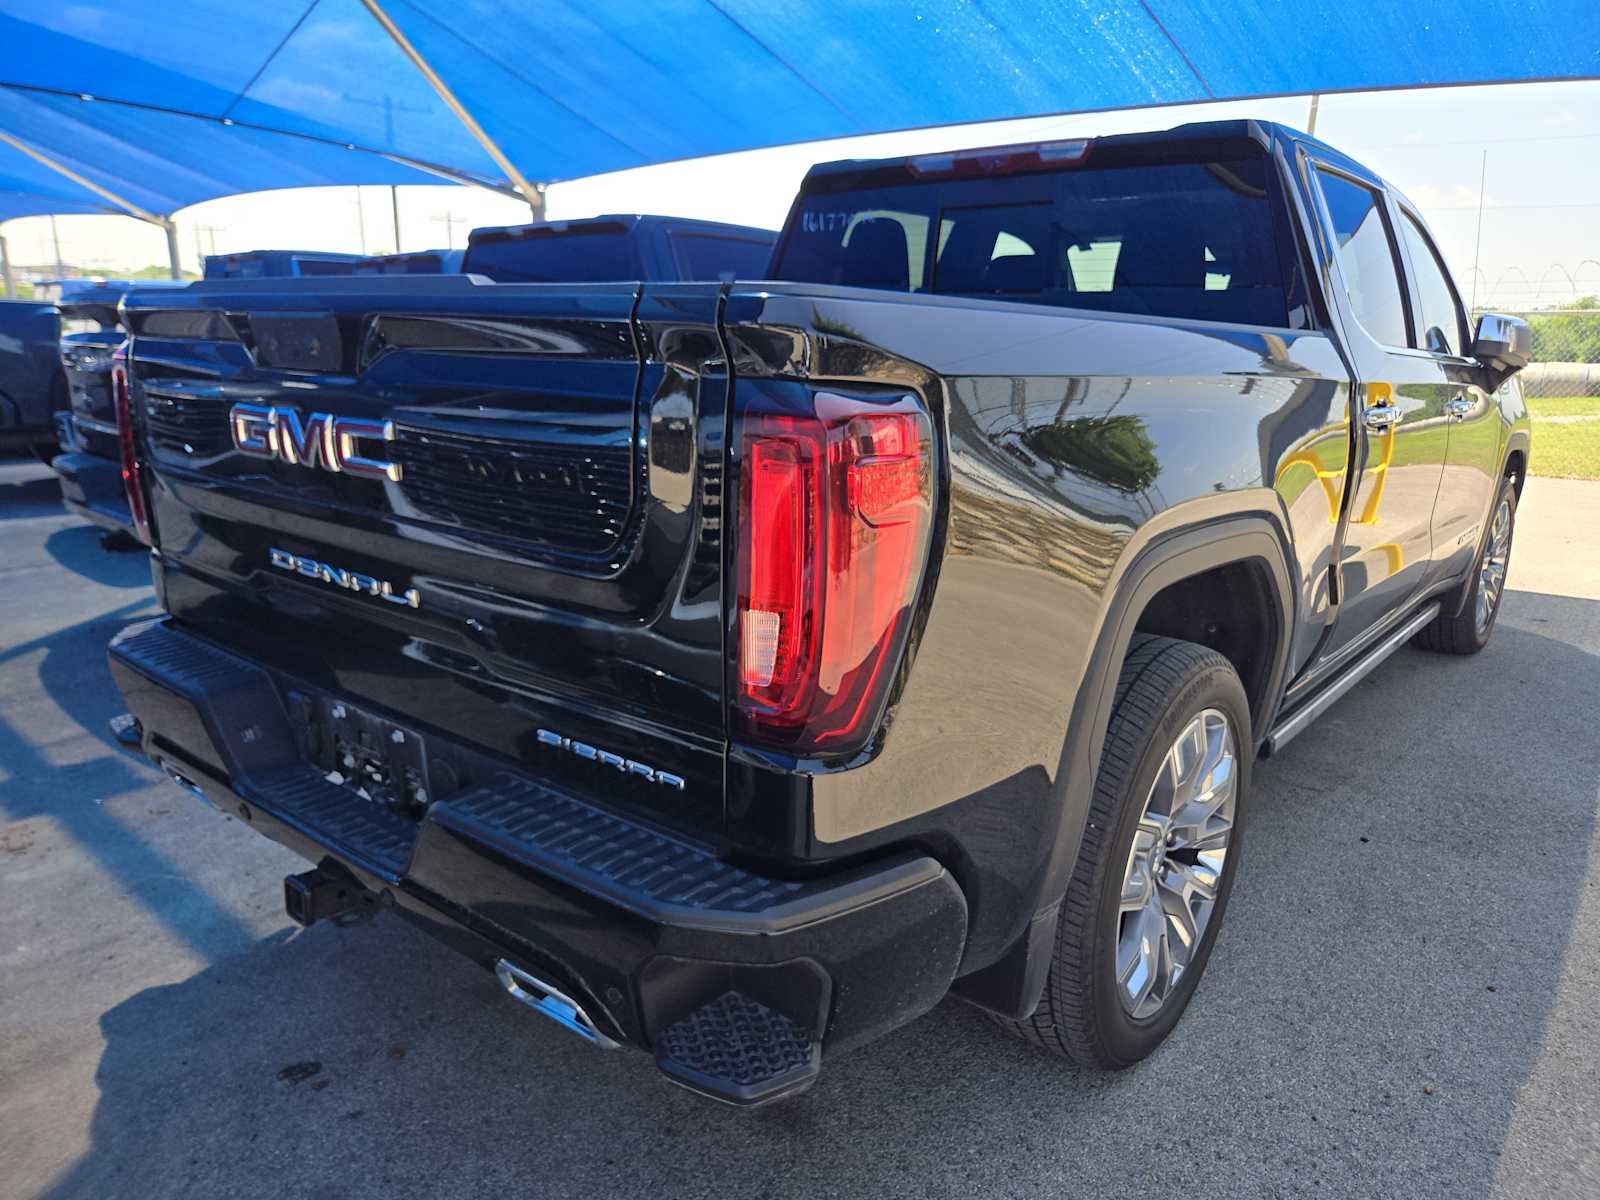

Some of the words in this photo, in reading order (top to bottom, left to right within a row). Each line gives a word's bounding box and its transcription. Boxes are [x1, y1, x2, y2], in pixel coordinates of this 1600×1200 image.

[230, 402, 403, 483] GMC
[269, 546, 422, 609] DENALI
[535, 728, 686, 791] SIERRA
